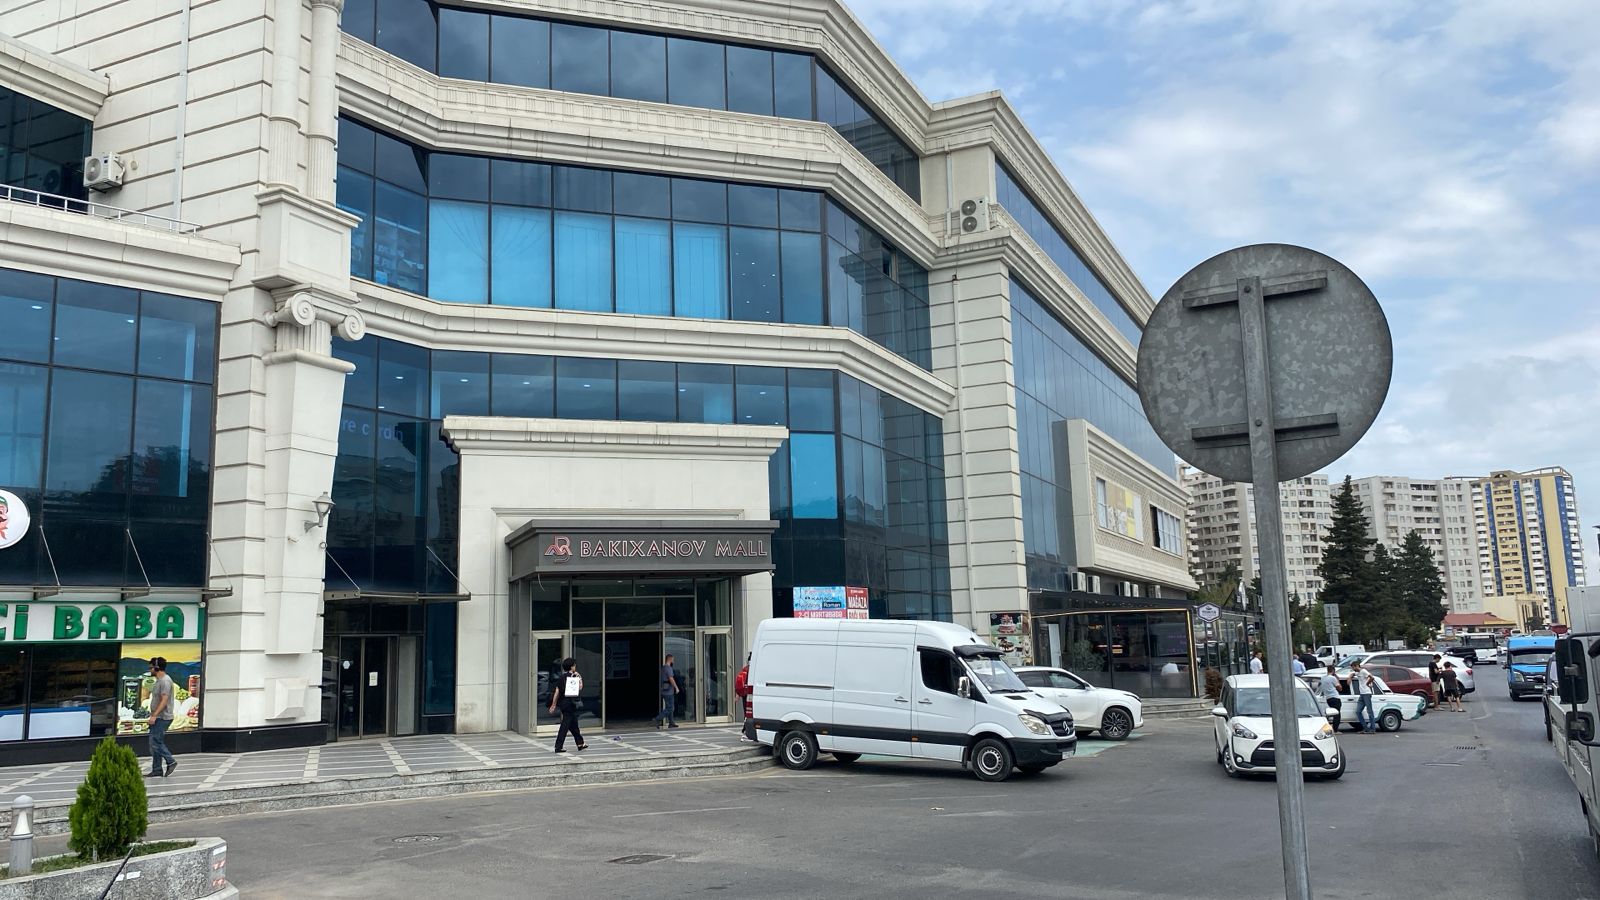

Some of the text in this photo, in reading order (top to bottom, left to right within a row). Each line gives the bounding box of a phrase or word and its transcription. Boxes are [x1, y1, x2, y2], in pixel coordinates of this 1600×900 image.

[581, 540, 706, 557] BAKIXANOV
[715, 540, 767, 557] MALL
[53, 605, 185, 640] BABA
